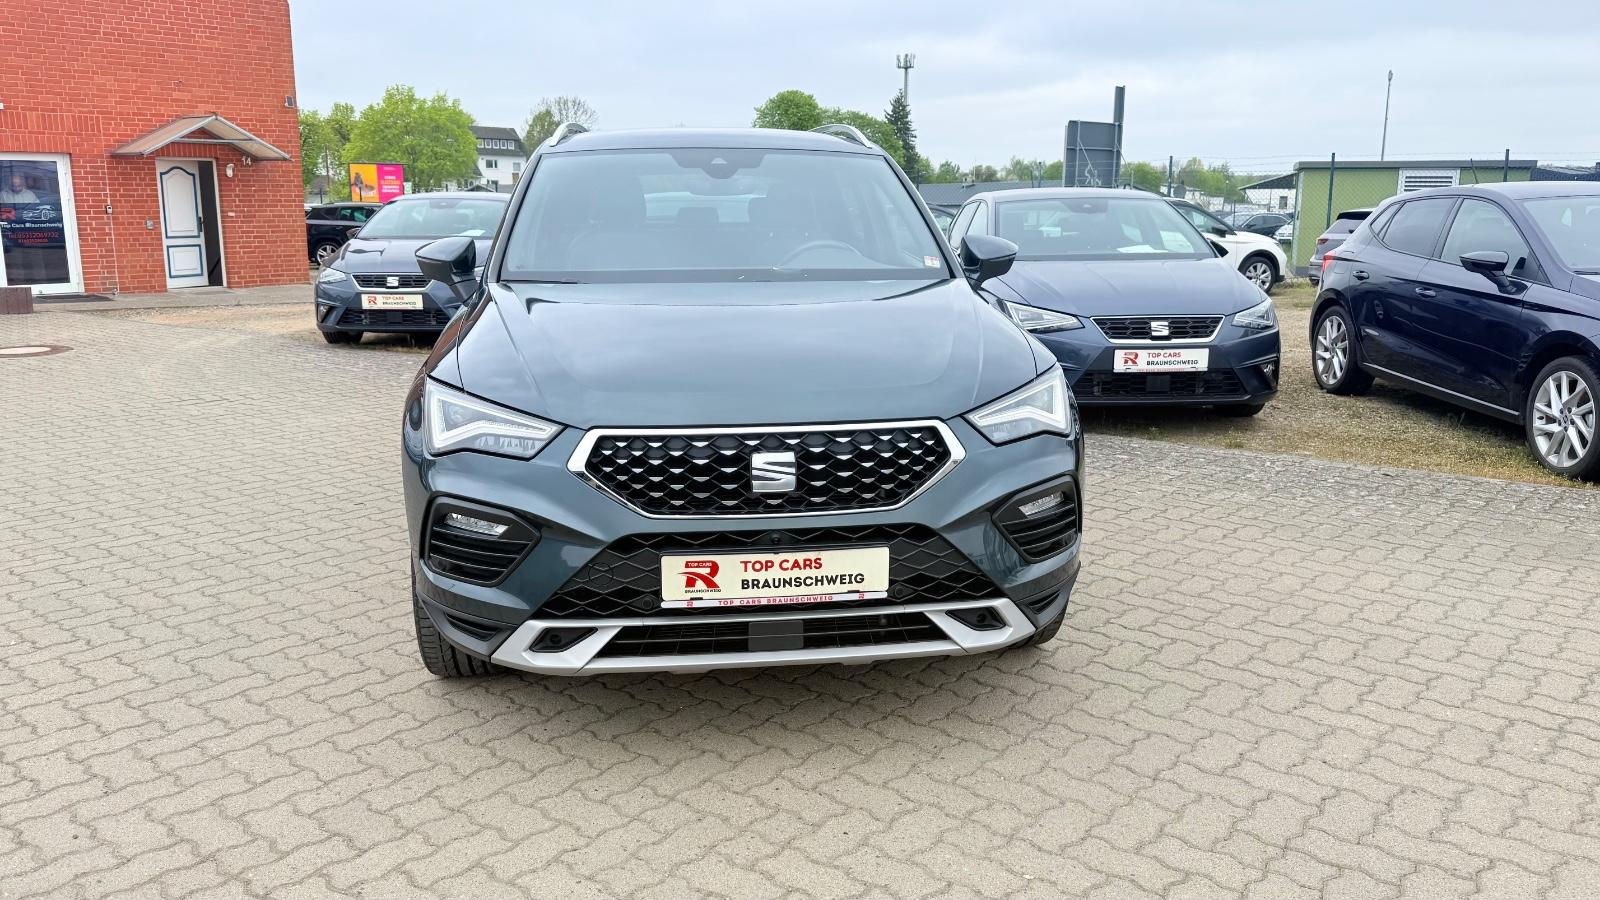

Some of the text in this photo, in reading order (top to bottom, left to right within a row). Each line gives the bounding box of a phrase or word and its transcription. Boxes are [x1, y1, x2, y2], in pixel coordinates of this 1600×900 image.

[242, 156, 251, 166] 14
[740, 557, 823, 573] TOP CARS
[740, 573, 865, 590] BRAUNSCHWEIG
[767, 595, 833, 604] BRAUNSCHWEIG
